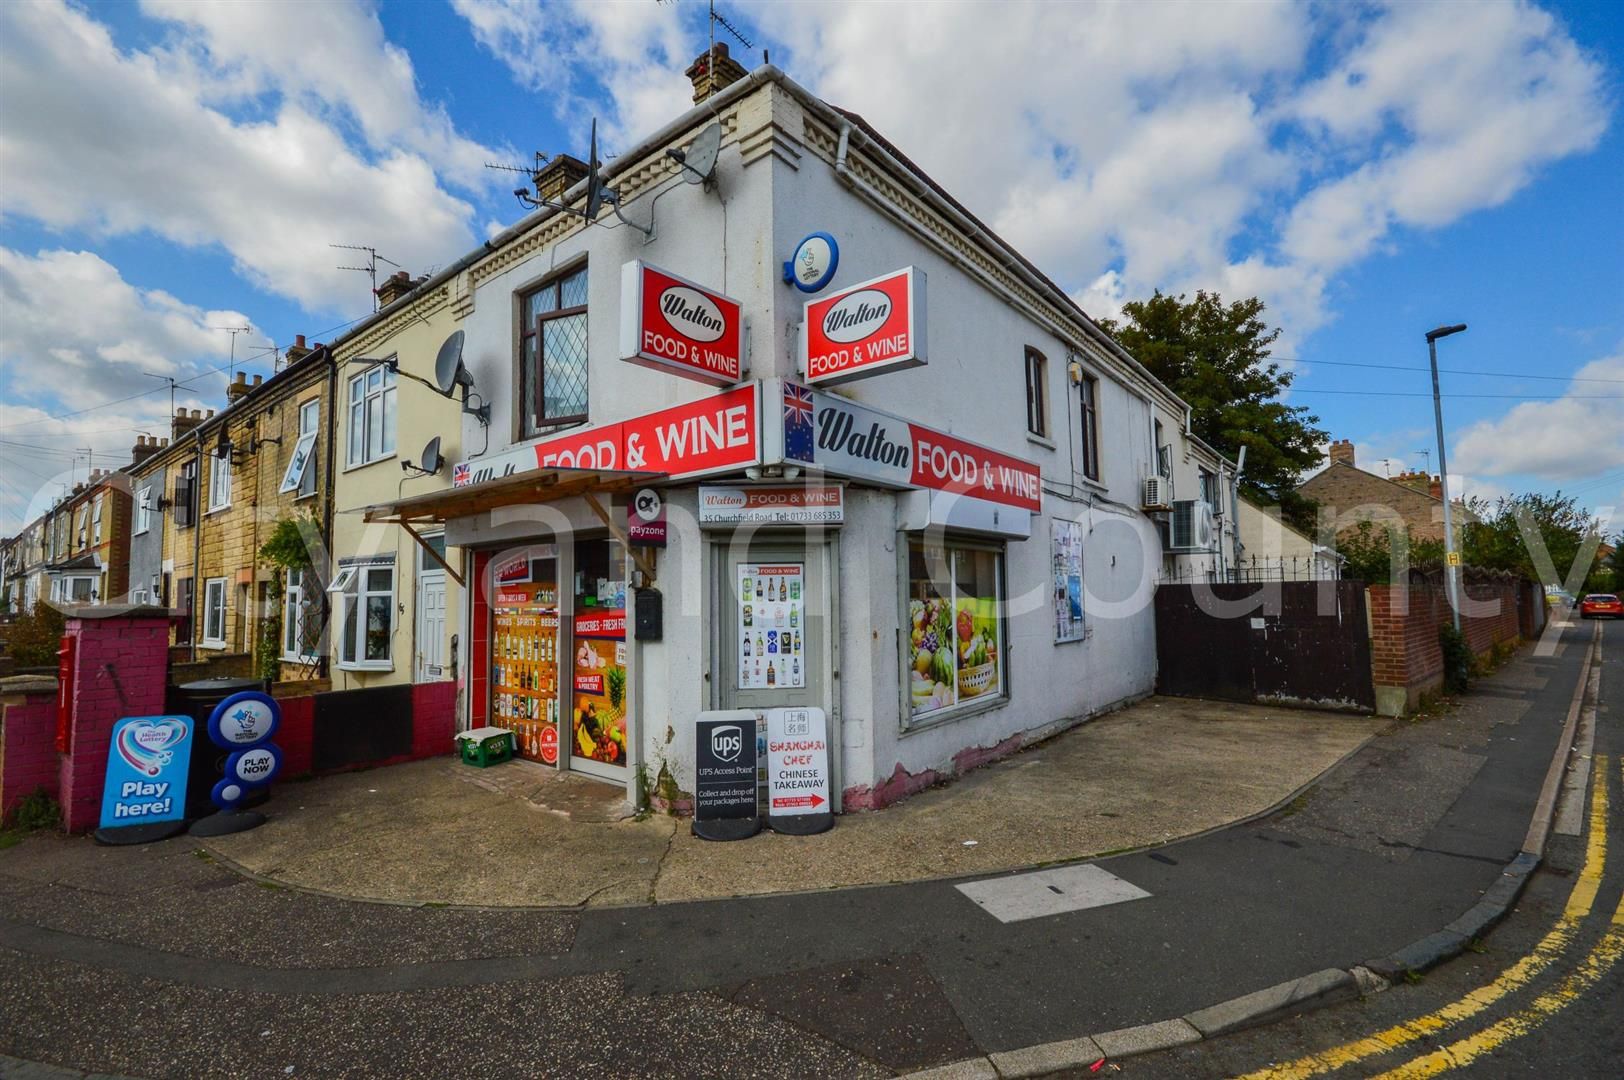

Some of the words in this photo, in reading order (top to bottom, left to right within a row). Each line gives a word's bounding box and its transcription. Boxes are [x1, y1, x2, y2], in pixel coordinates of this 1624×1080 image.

[664, 294, 721, 332] Walton
[826, 303, 887, 333] Walton
[644, 330, 687, 359] FOOD
[691, 346, 700, 364] &
[704, 349, 737, 374] WINE
[810, 350, 849, 375] FOOD
[853, 346, 863, 364] &
[867, 333, 907, 359] WINE
[627, 432, 647, 469] &
[655, 405, 749, 462] WINE
[818, 407, 909, 468] Walton
[917, 440, 978, 486] FOOD
[983, 460, 995, 491] &
[999, 465, 1039, 500] WINE
[705, 495, 743, 506] Walton
[750, 494, 786, 504] FOOD
[790, 494, 800, 503] &
[803, 492, 838, 502] WINE
[704, 514, 712, 523] 35
[714, 512, 753, 522] Churchfield
[755, 512, 773, 521] Road
[776, 512, 790, 520] Tel:
[790, 512, 811, 520] 01733
[814, 511, 826, 520] 685
[828, 510, 841, 519] 353
[630, 526, 664, 536] payzone
[576, 620, 600, 632] GROCERIES
[603, 618, 617, 630] FRESH
[714, 736, 740, 756] ups
[770, 740, 825, 752] SHANGHAI
[244, 757, 270, 766] PLAY
[783, 755, 813, 766] CHEF
[244, 765, 270, 774] NOW
[699, 768, 713, 776] UPS
[780, 769, 818, 779] CHINESE
[122, 782, 168, 798] Play
[774, 780, 824, 789] TAKEAWAY
[699, 790, 719, 798] Collect
[732, 789, 746, 797] drop
[114, 798, 171, 817] here!
[713, 798, 740, 806] packages
